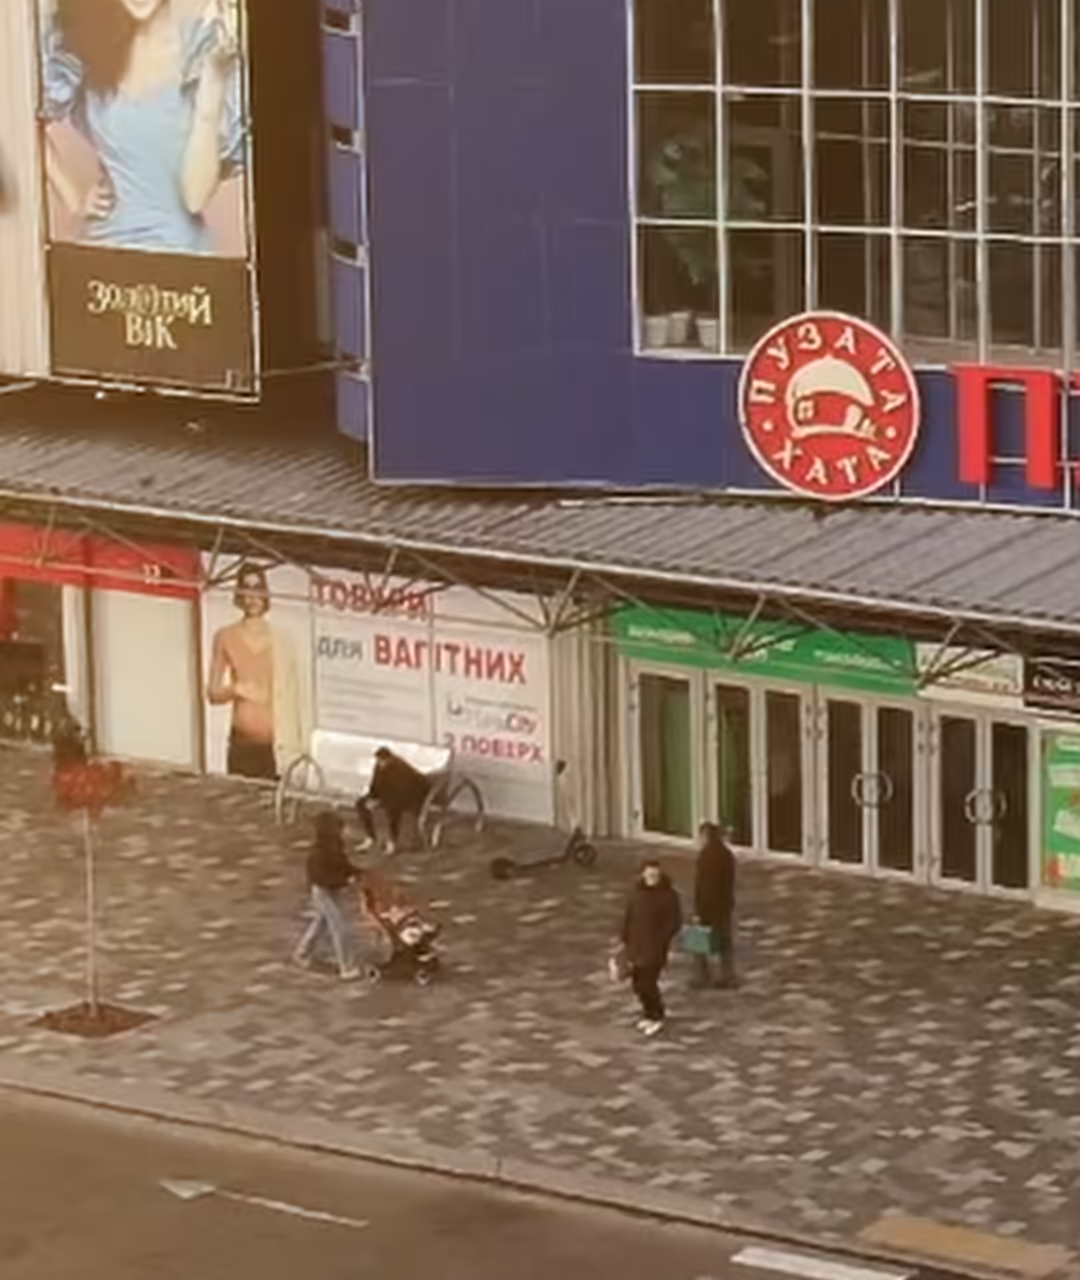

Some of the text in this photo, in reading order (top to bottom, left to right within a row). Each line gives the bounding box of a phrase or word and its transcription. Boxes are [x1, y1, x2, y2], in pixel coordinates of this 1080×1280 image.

[749, 322, 907, 414] ПУЗАТА
[772, 438, 892, 485] ХАТА
[373, 634, 528, 685] ВАГІТНИХ
